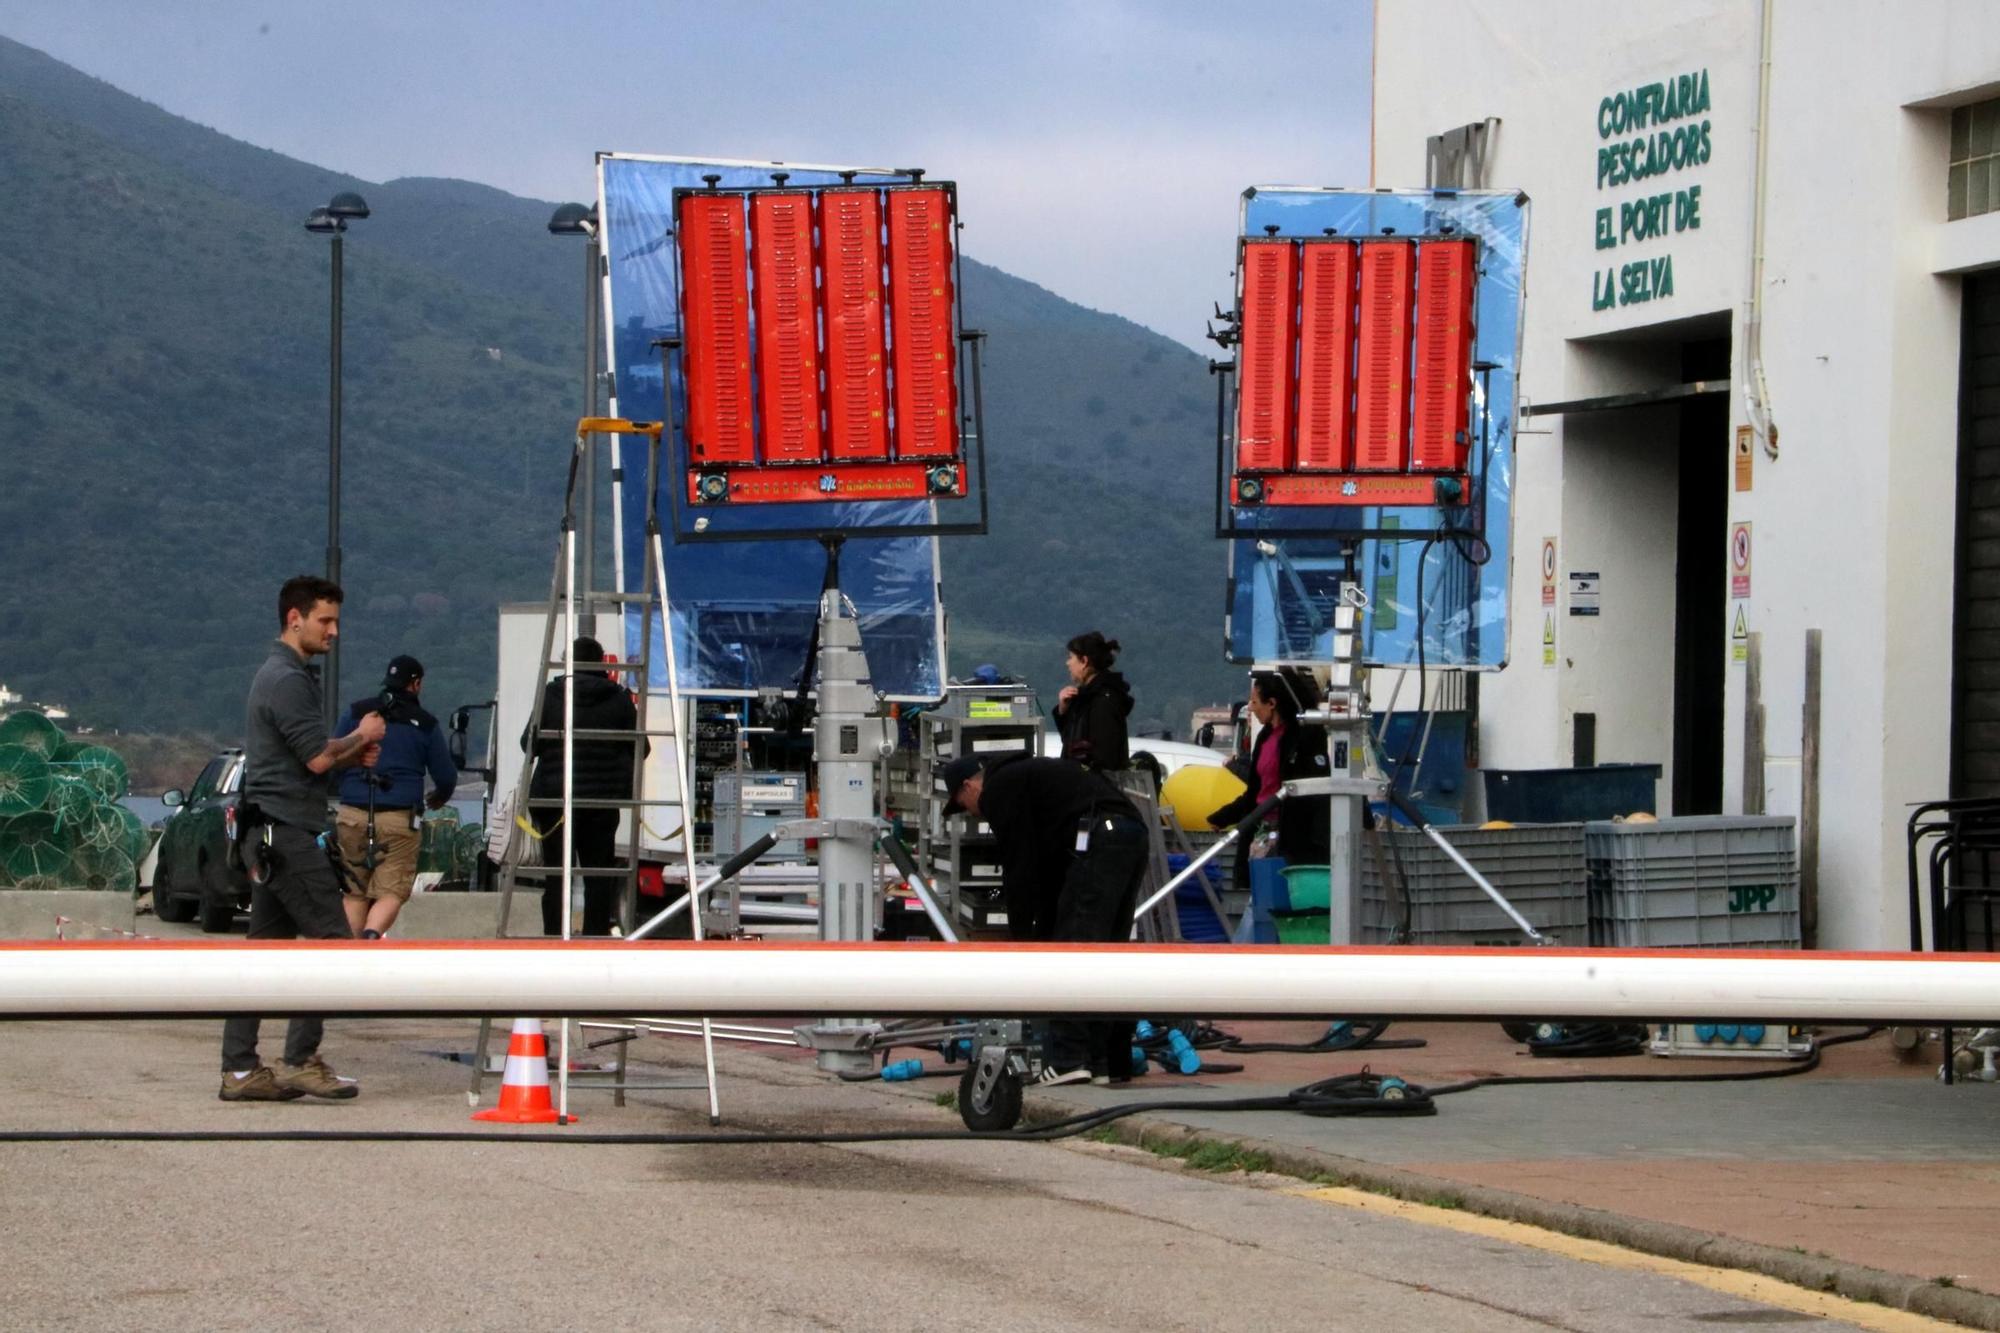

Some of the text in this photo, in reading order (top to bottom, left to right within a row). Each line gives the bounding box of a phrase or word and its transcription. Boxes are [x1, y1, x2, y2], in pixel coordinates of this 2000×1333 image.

[1598, 68, 1711, 139] CONFRARIA
[1597, 119, 1712, 190] PESCADORS
[1595, 185, 1701, 250] EL PORT DE
[1592, 254, 1674, 311] LA SELVA
[1728, 885, 1776, 912] JPP
